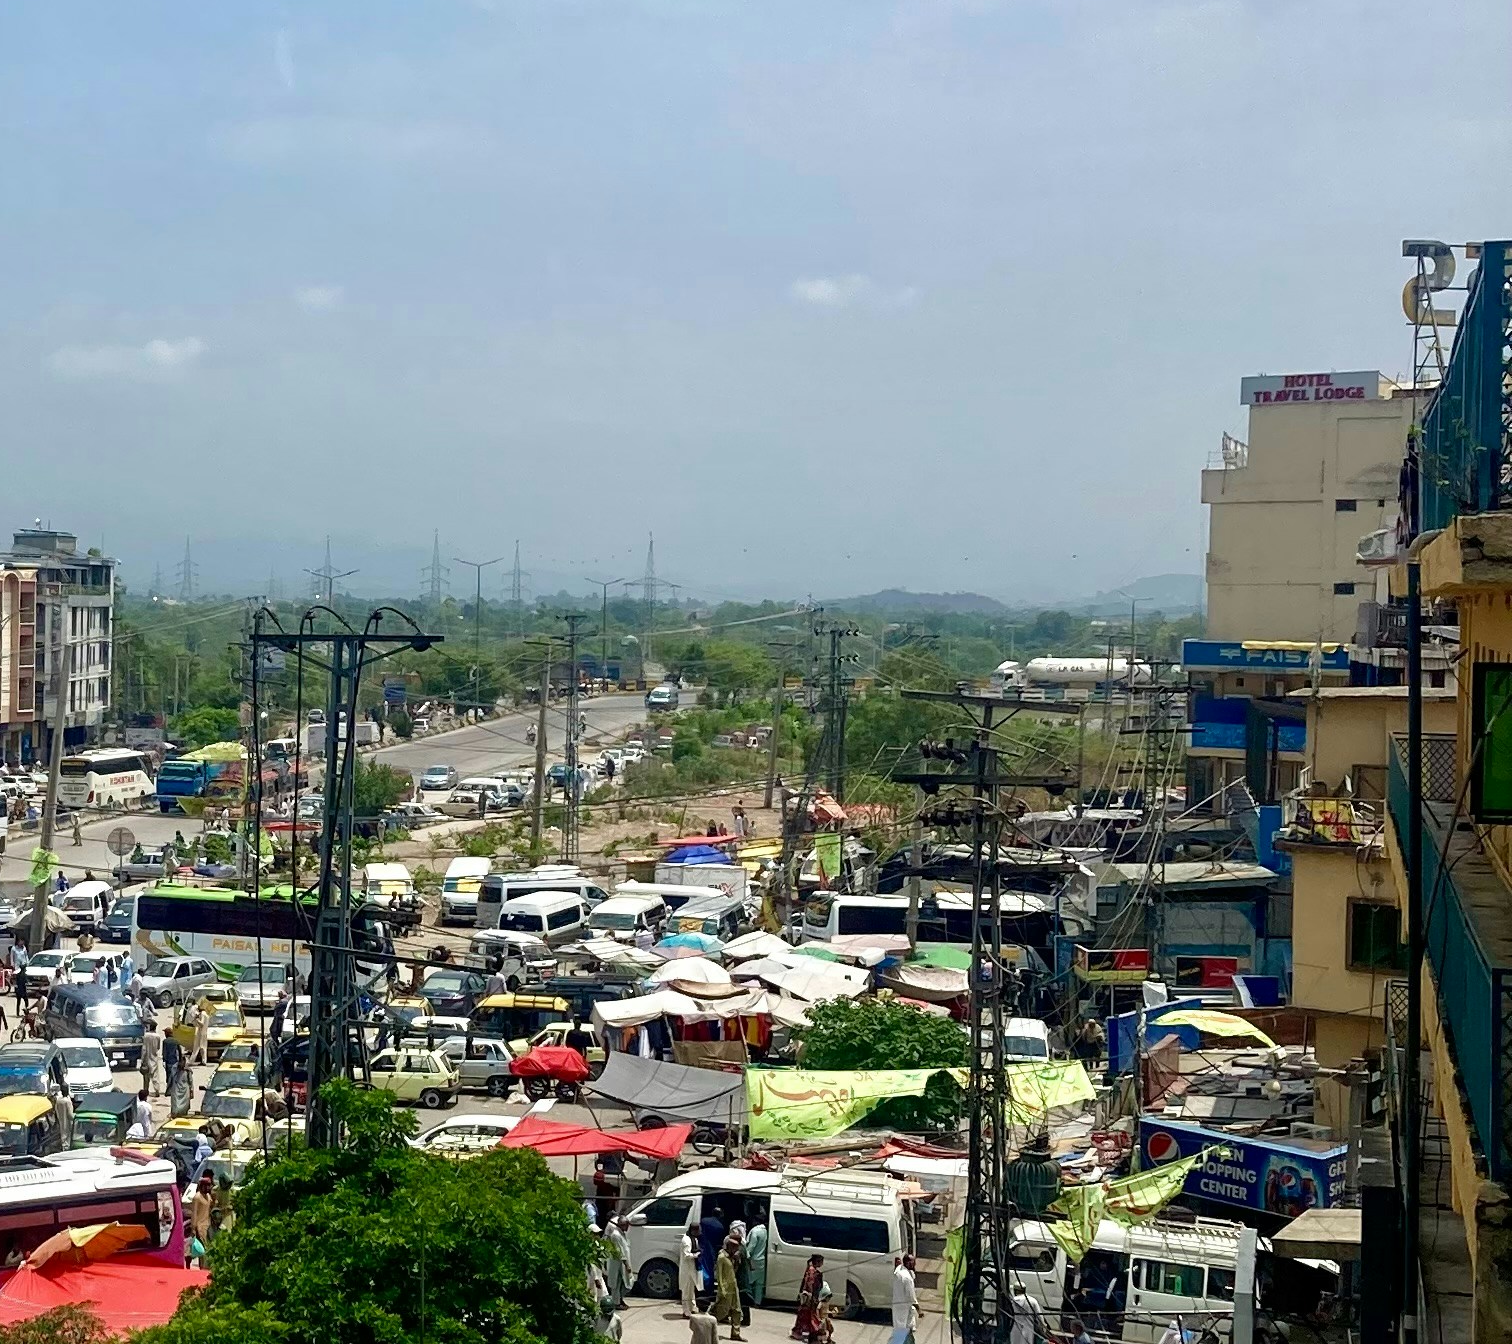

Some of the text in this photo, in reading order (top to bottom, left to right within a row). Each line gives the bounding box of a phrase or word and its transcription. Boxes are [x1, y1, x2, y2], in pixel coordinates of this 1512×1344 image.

[1284, 374, 1333, 388] HOTEL
[1253, 387, 1365, 403] TRAVEL LODGE
[1197, 1158, 1257, 1184] HOPPING
[1200, 1178, 1248, 1202] CENTER
